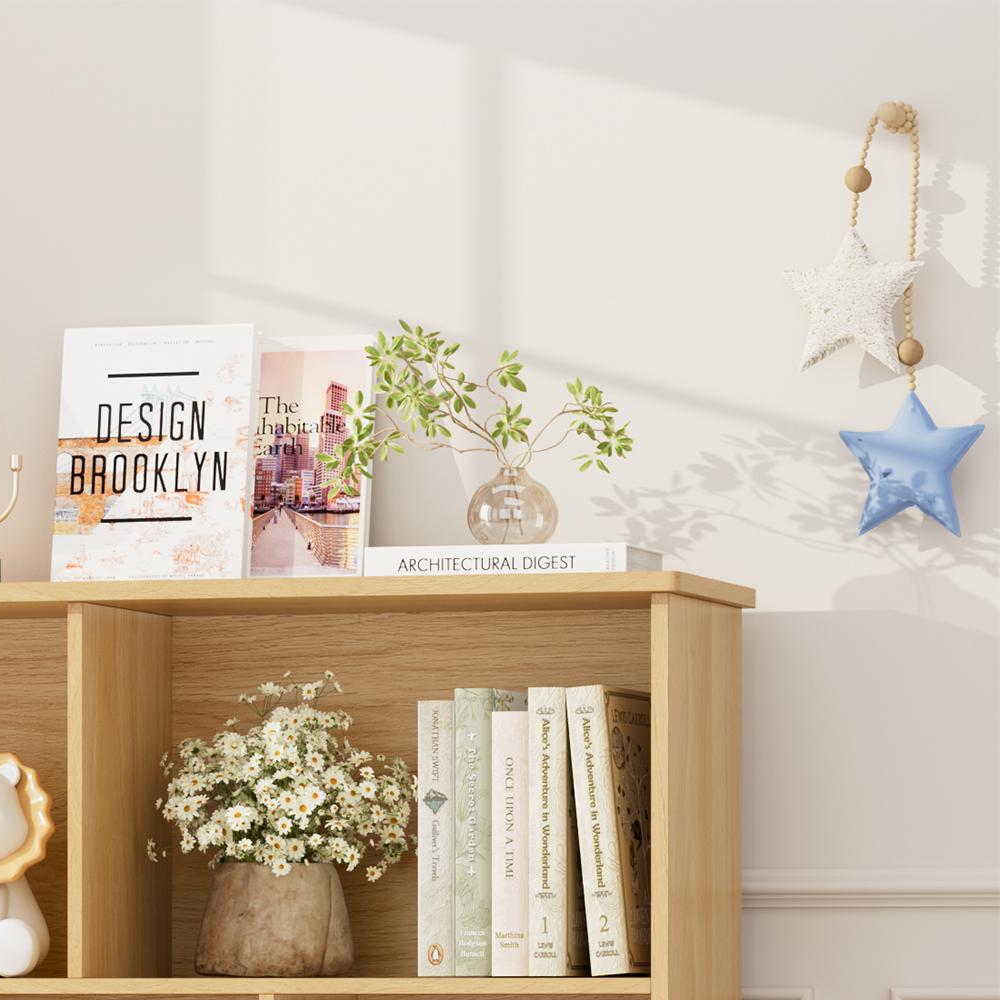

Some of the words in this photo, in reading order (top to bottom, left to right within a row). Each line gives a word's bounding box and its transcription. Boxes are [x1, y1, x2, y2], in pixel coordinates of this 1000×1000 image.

[96, 400, 206, 444] DESIGN
[258, 396, 300, 415] The
[70, 451, 228, 496] BROOKLYN
[397, 556, 518, 572] ARCHITECTURAL
[522, 555, 576, 570] DIGEST
[431, 710, 440, 754] JONATHAN
[541, 718, 551, 750] Alice's
[582, 717, 593, 750] Alice's
[431, 756, 440, 782] SWIFT
[504, 757, 514, 791] ONCE
[541, 753, 551, 810] Adventure
[585, 752, 597, 809] Adventure
[504, 796, 514, 832] UPON
[505, 836, 514, 845] A
[541, 824, 551, 890] Wonderland
[592, 822, 606, 889] Wonderland
[504, 852, 514, 881] TIME
[541, 916, 549, 934] 1
[599, 914, 610, 933] 2
